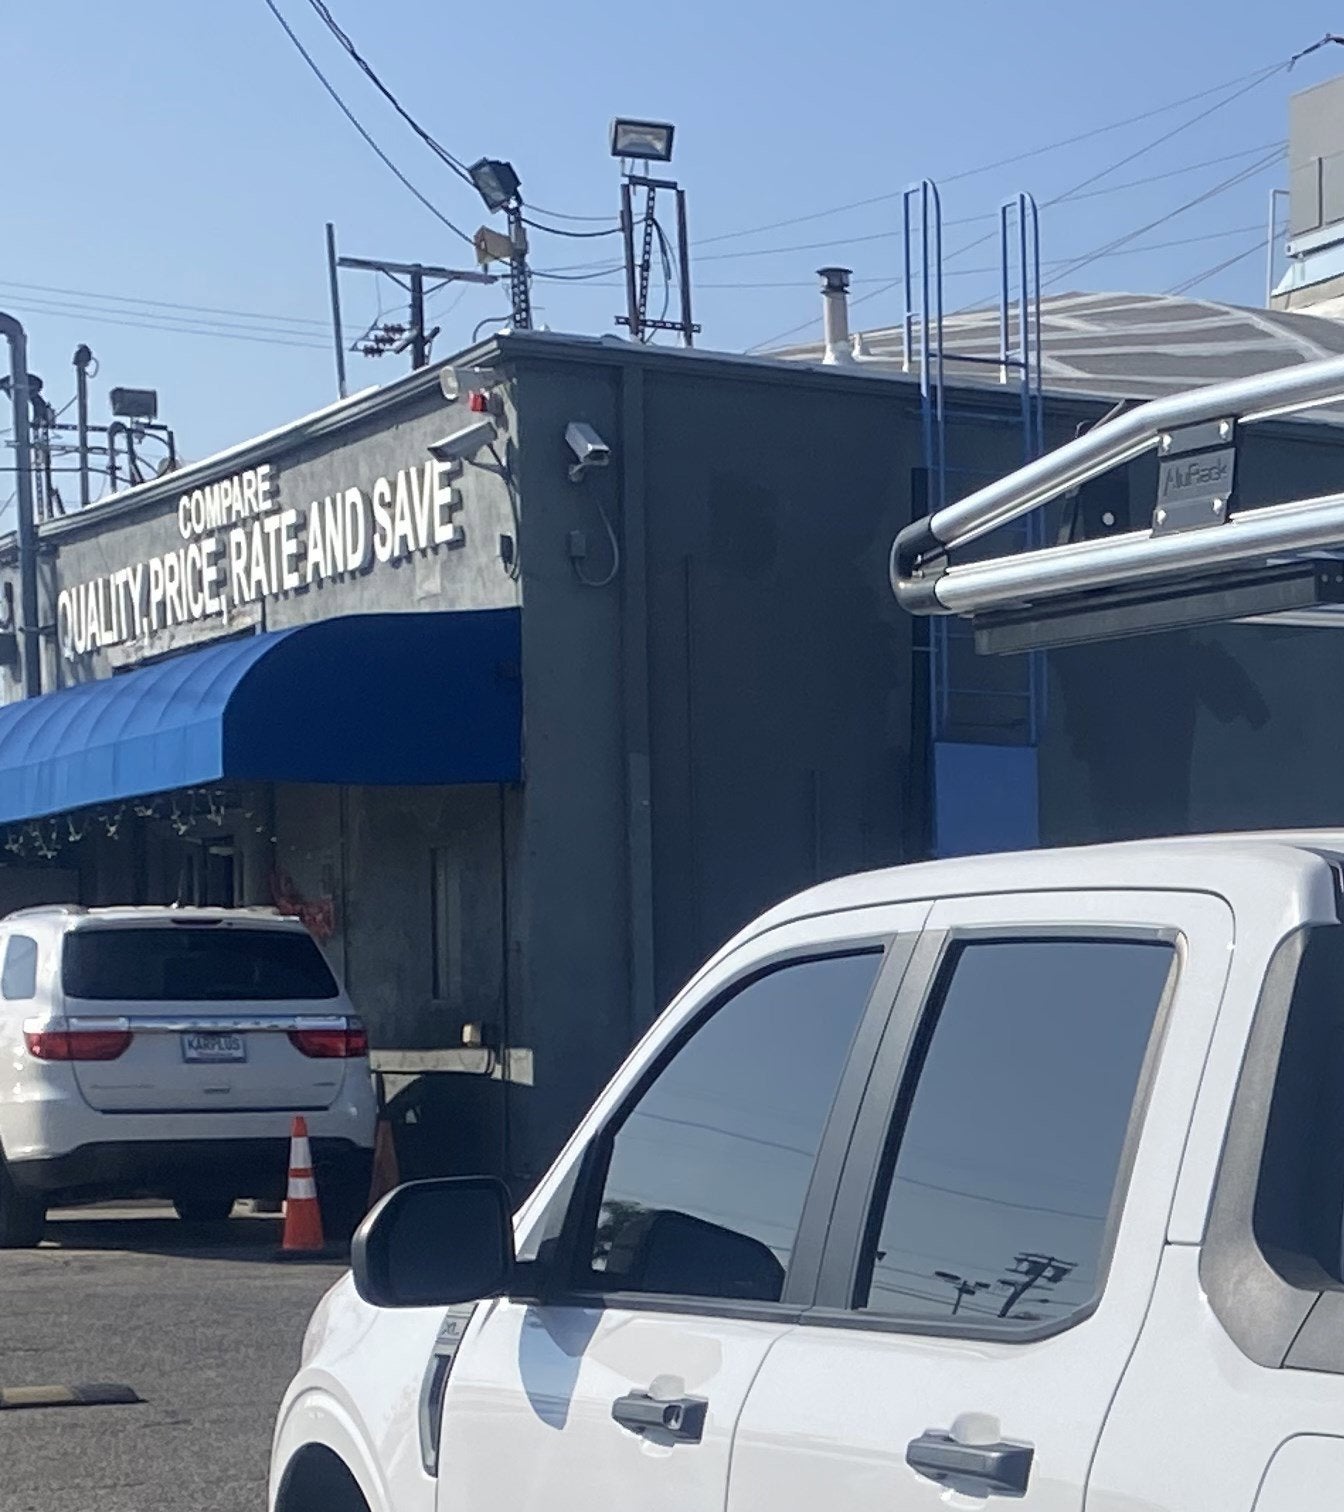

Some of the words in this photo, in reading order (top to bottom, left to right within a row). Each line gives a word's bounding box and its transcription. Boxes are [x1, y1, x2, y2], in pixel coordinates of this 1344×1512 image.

[178, 465, 272, 540] COMPARE
[229, 509, 299, 602] RATE
[307, 486, 368, 584] AND
[373, 461, 456, 562] SAVE
[187, 1034, 241, 1051] KARPLUS
